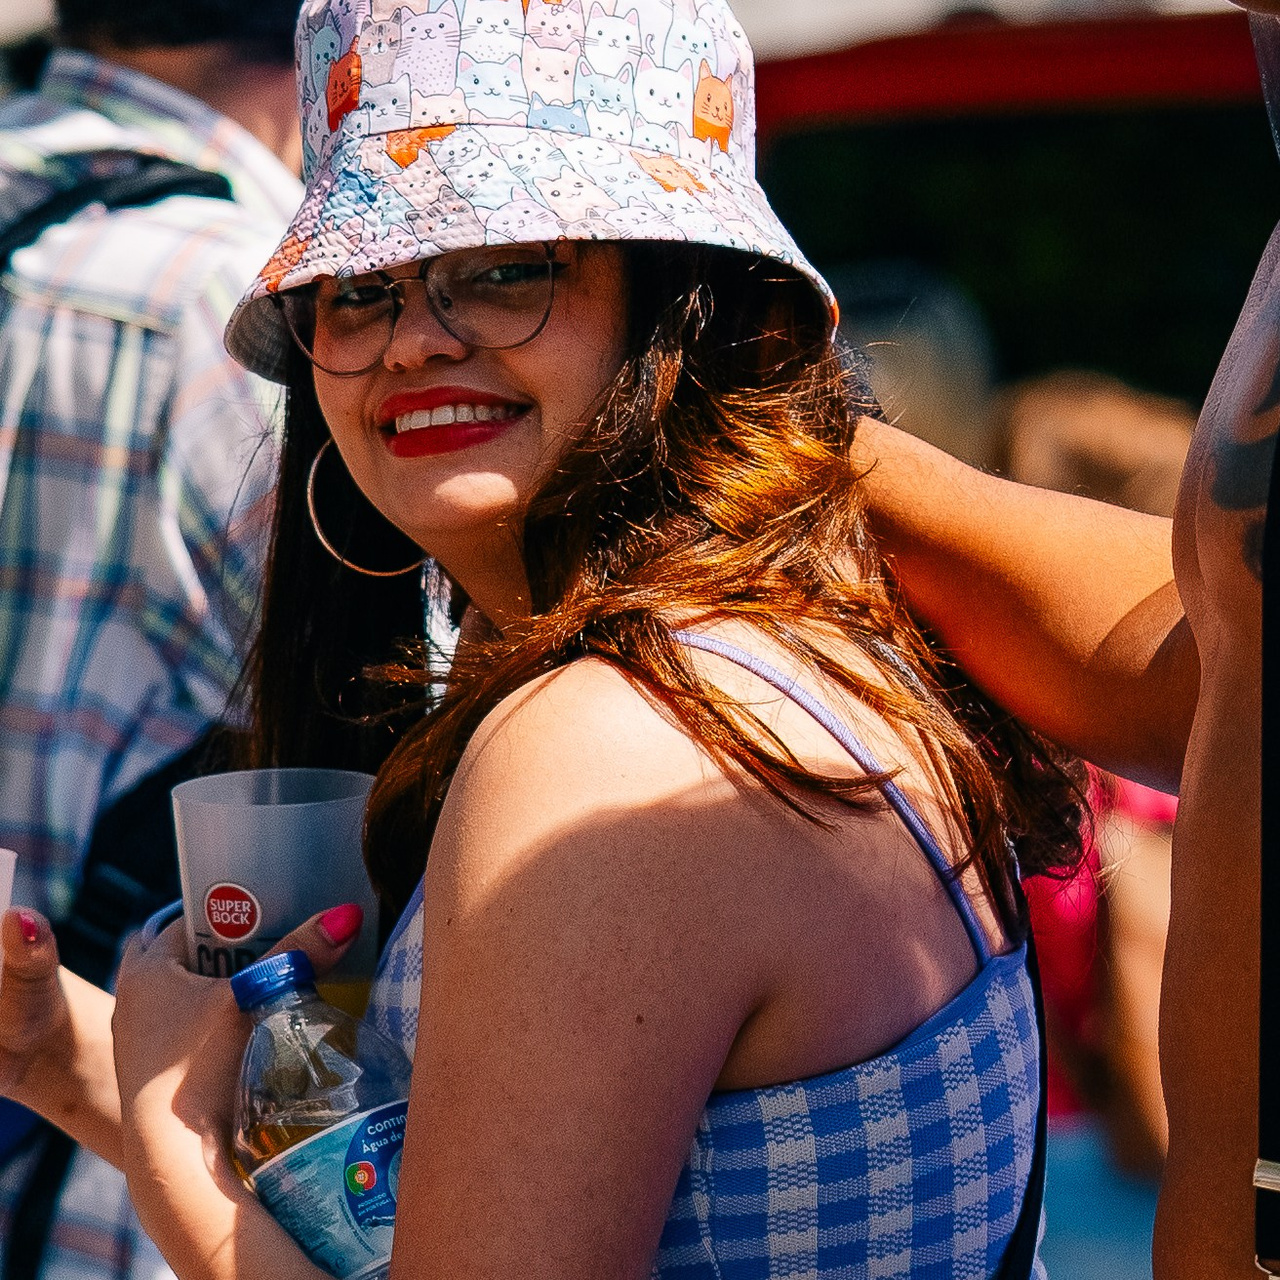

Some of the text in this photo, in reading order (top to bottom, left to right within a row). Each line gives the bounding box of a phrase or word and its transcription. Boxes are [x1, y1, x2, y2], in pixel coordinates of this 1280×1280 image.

[211, 899, 252, 912] SUPER
[212, 911, 250, 925] BOCK
[361, 1131, 403, 1154] Água de
